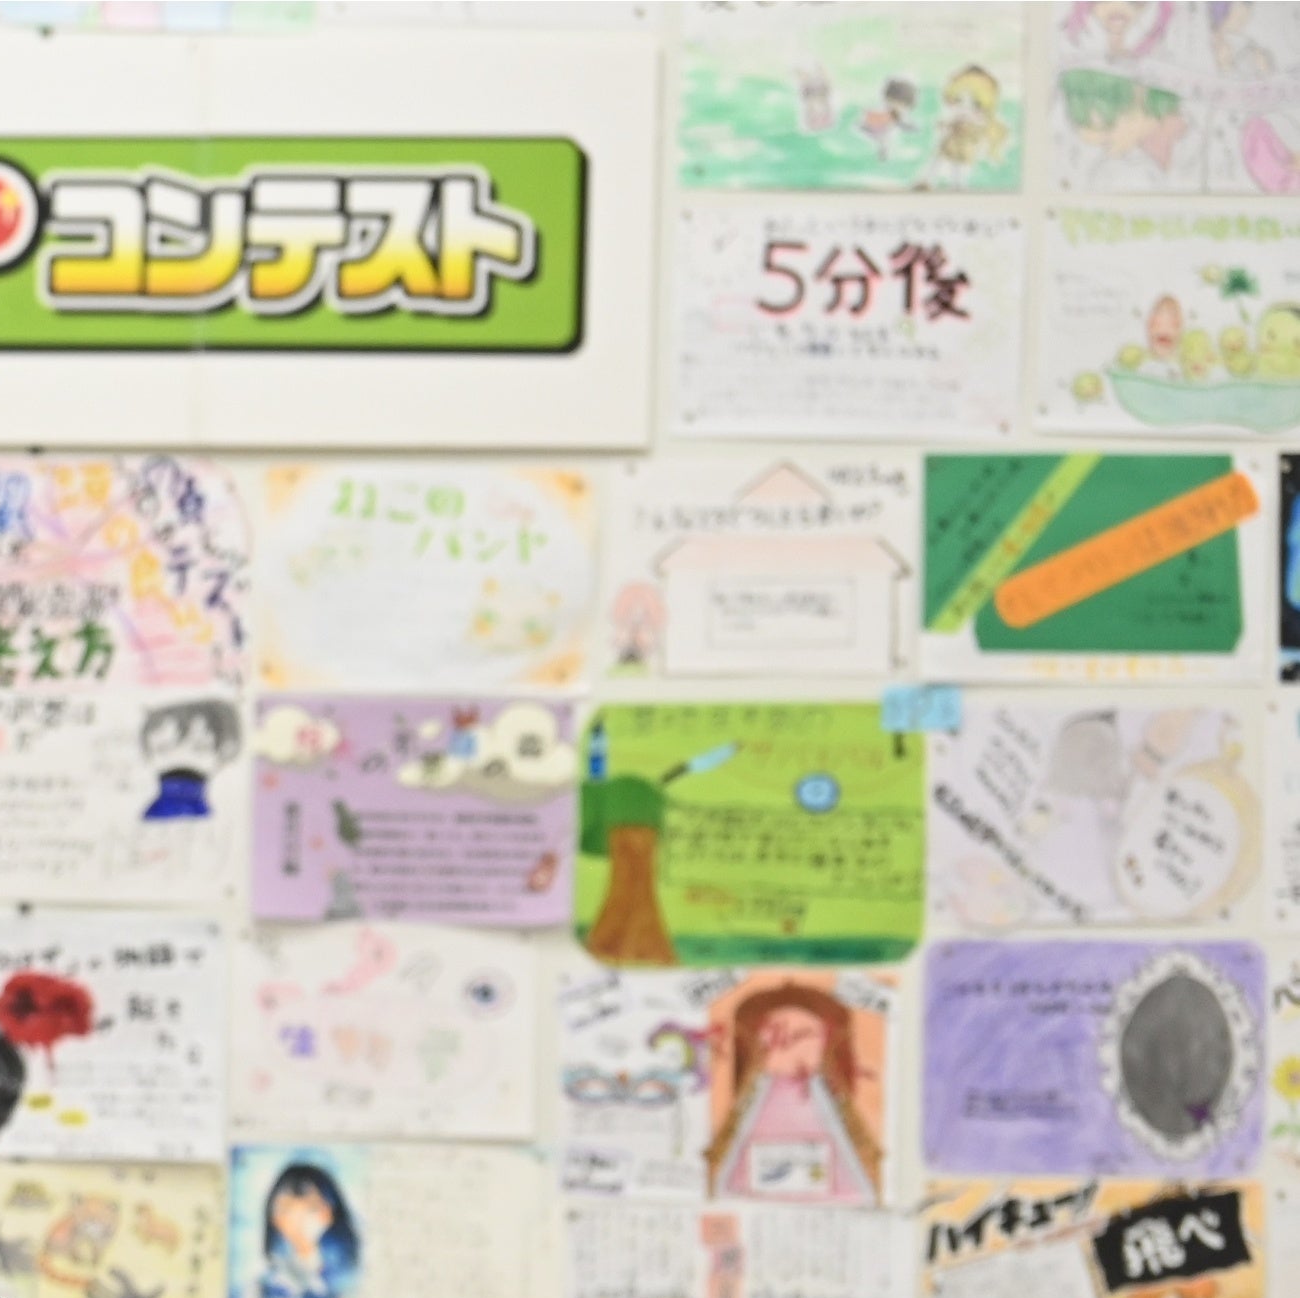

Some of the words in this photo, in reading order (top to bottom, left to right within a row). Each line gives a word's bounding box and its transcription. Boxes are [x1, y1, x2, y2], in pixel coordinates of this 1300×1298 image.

[754, 238, 972, 324] 5分後
[329, 479, 466, 524] ねこの
[1122, 1207, 1225, 1278] 飛べ
